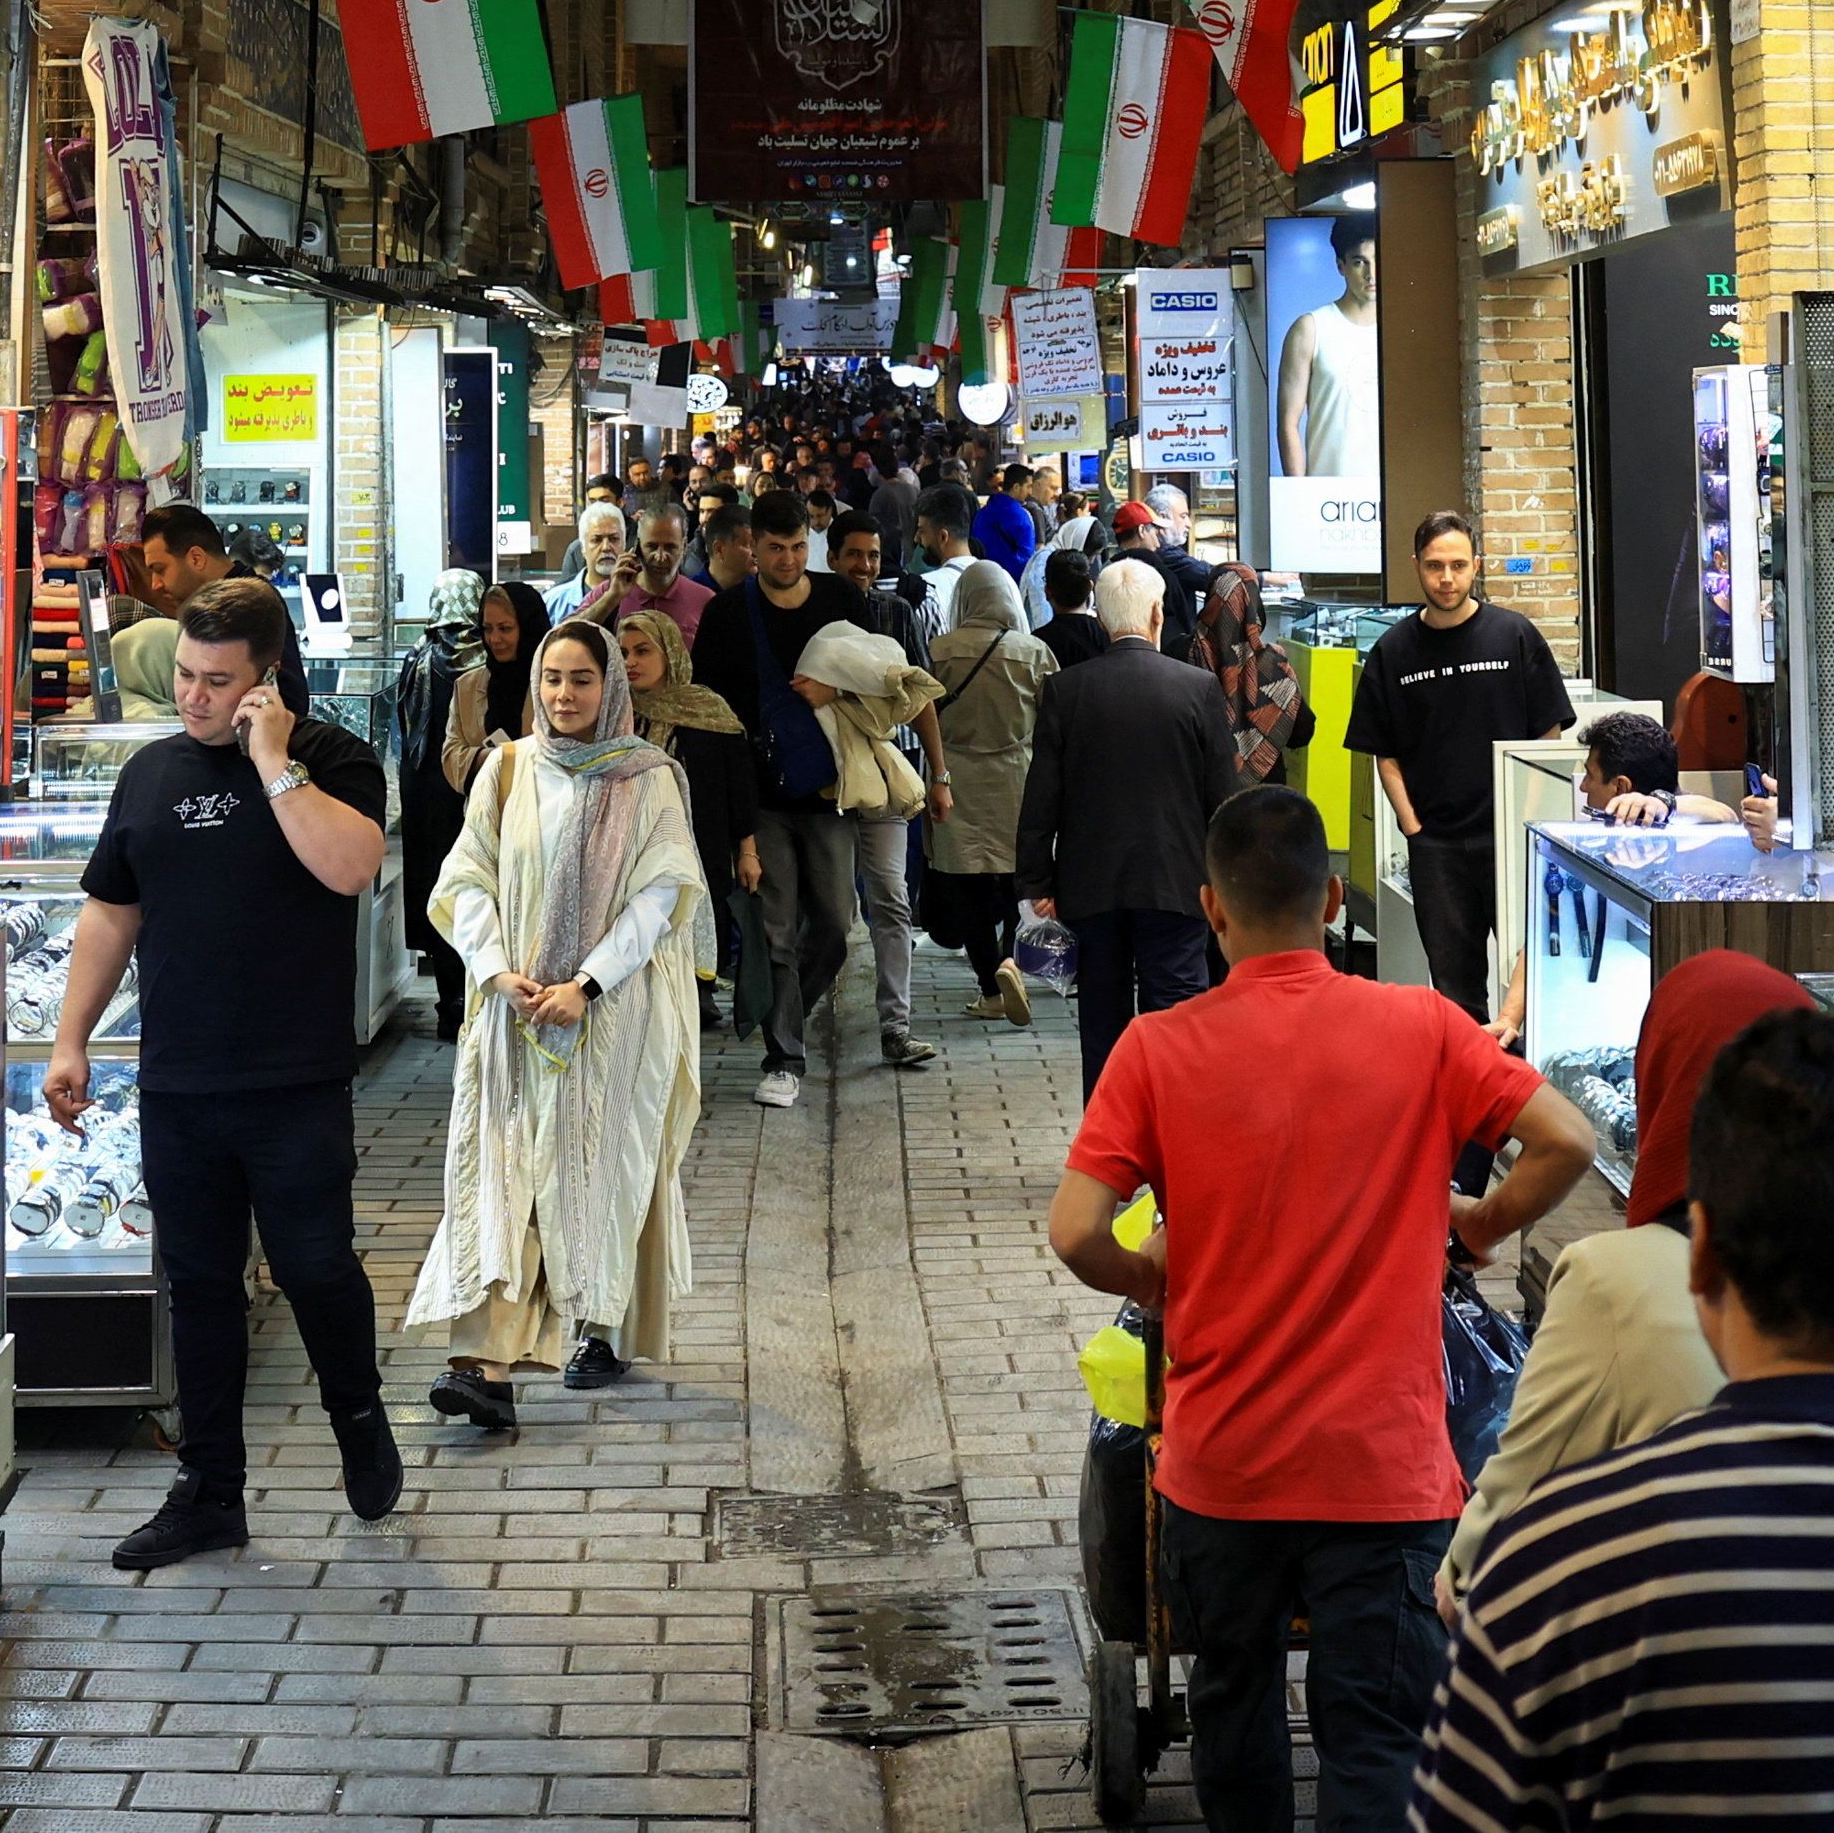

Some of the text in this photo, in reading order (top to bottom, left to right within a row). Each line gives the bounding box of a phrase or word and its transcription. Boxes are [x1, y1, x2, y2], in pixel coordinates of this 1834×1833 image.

[1152, 295, 1216, 308] CASIO
[1155, 340, 1216, 358] تخفیف ویژه
[1148, 361, 1226, 381] عروس و داماد
[228, 380, 313, 402] تعویض بند
[253, 413, 280, 432] پذیرفته
[283, 411, 306, 431] باطری
[1168, 408, 1207, 421] فروش
[1199, 424, 1228, 438] بند
[1162, 451, 1215, 463] CASIO
[1320, 497, 1382, 523] aria
[1401, 660, 1509, 685] BELIEVE IN YOURSELF
